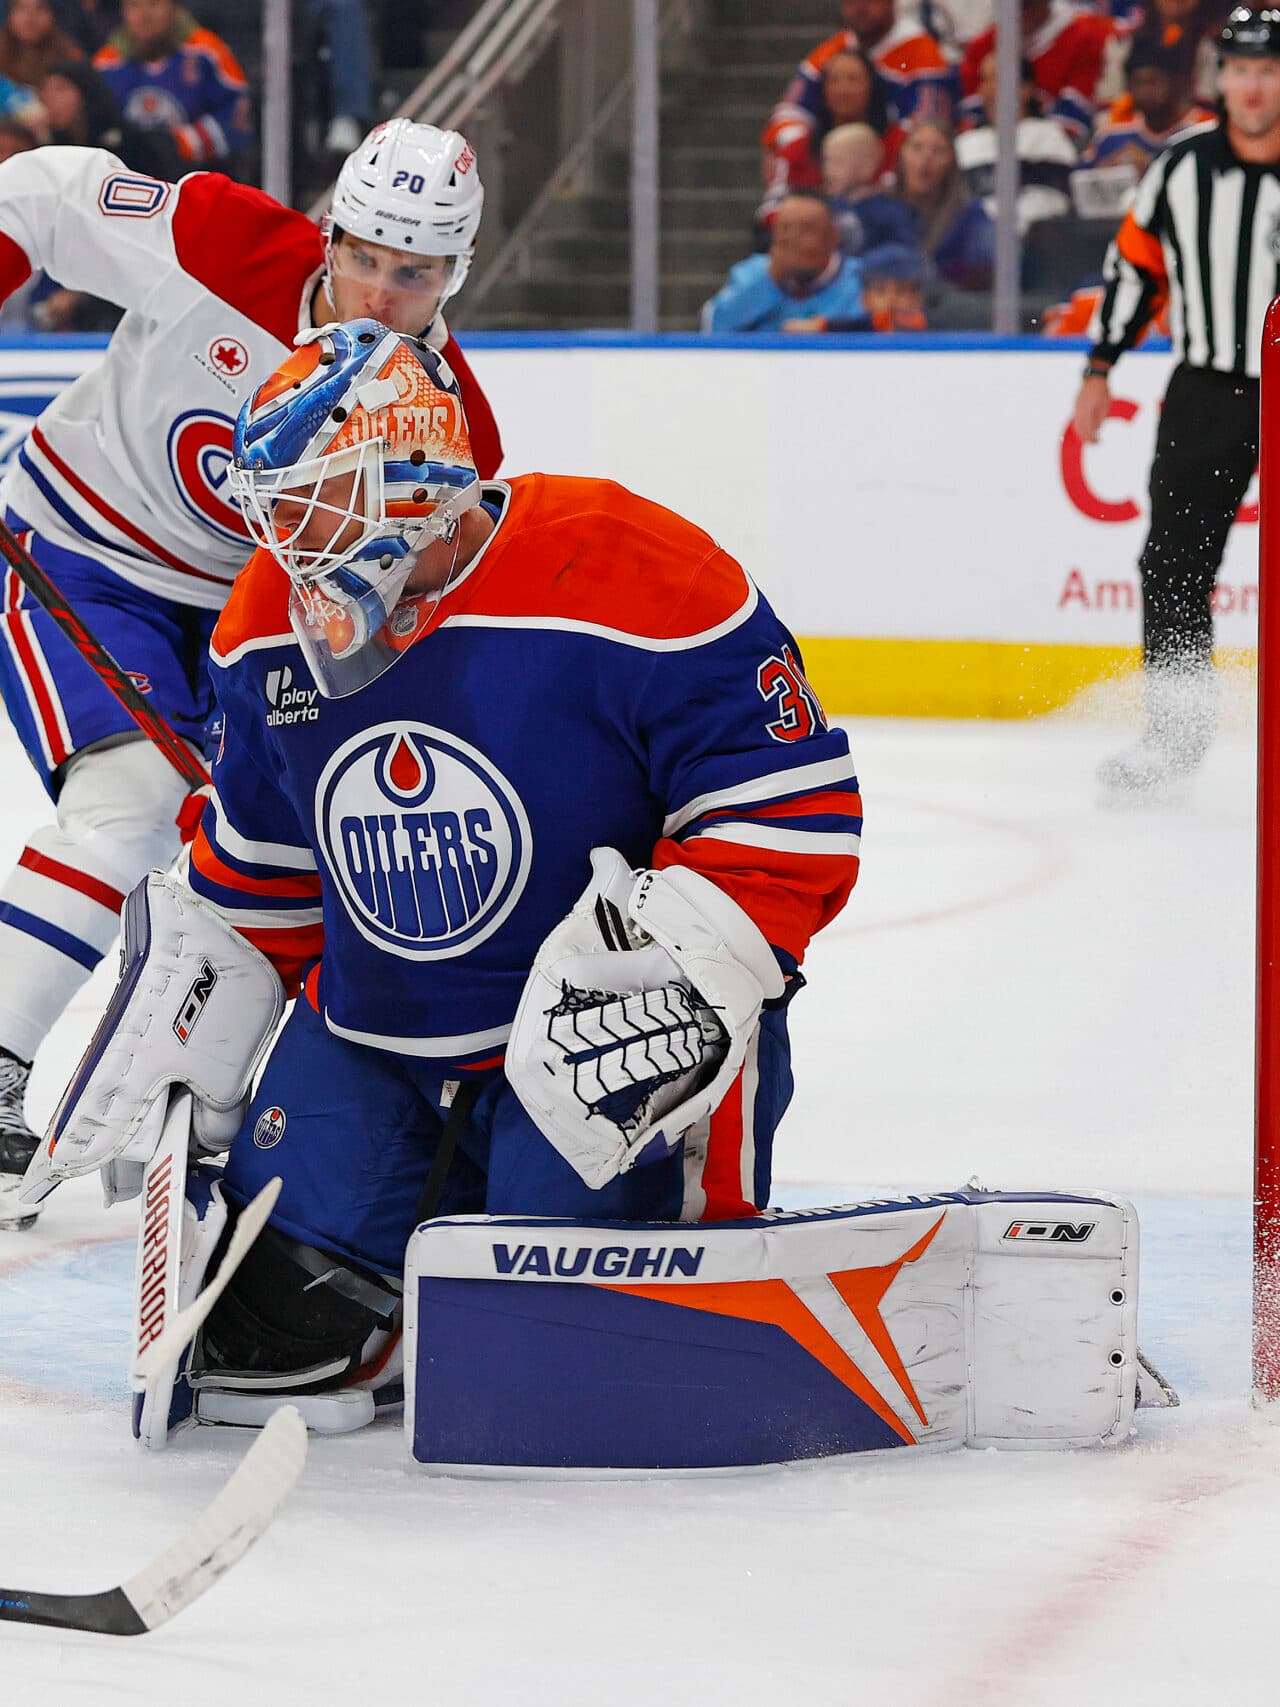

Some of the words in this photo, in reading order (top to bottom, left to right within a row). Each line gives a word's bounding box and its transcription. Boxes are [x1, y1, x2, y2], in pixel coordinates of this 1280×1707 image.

[98, 166, 170, 218] 0
[392, 170, 425, 194] 20
[193, 353, 206, 367] AIR
[206, 365, 236, 395] CANADA
[266, 706, 320, 726] alberta
[281, 688, 318, 709] play
[340, 808, 498, 938] OILERS
[137, 1153, 173, 1359] WARRIOR
[492, 1243, 705, 1279] VAUGHN
